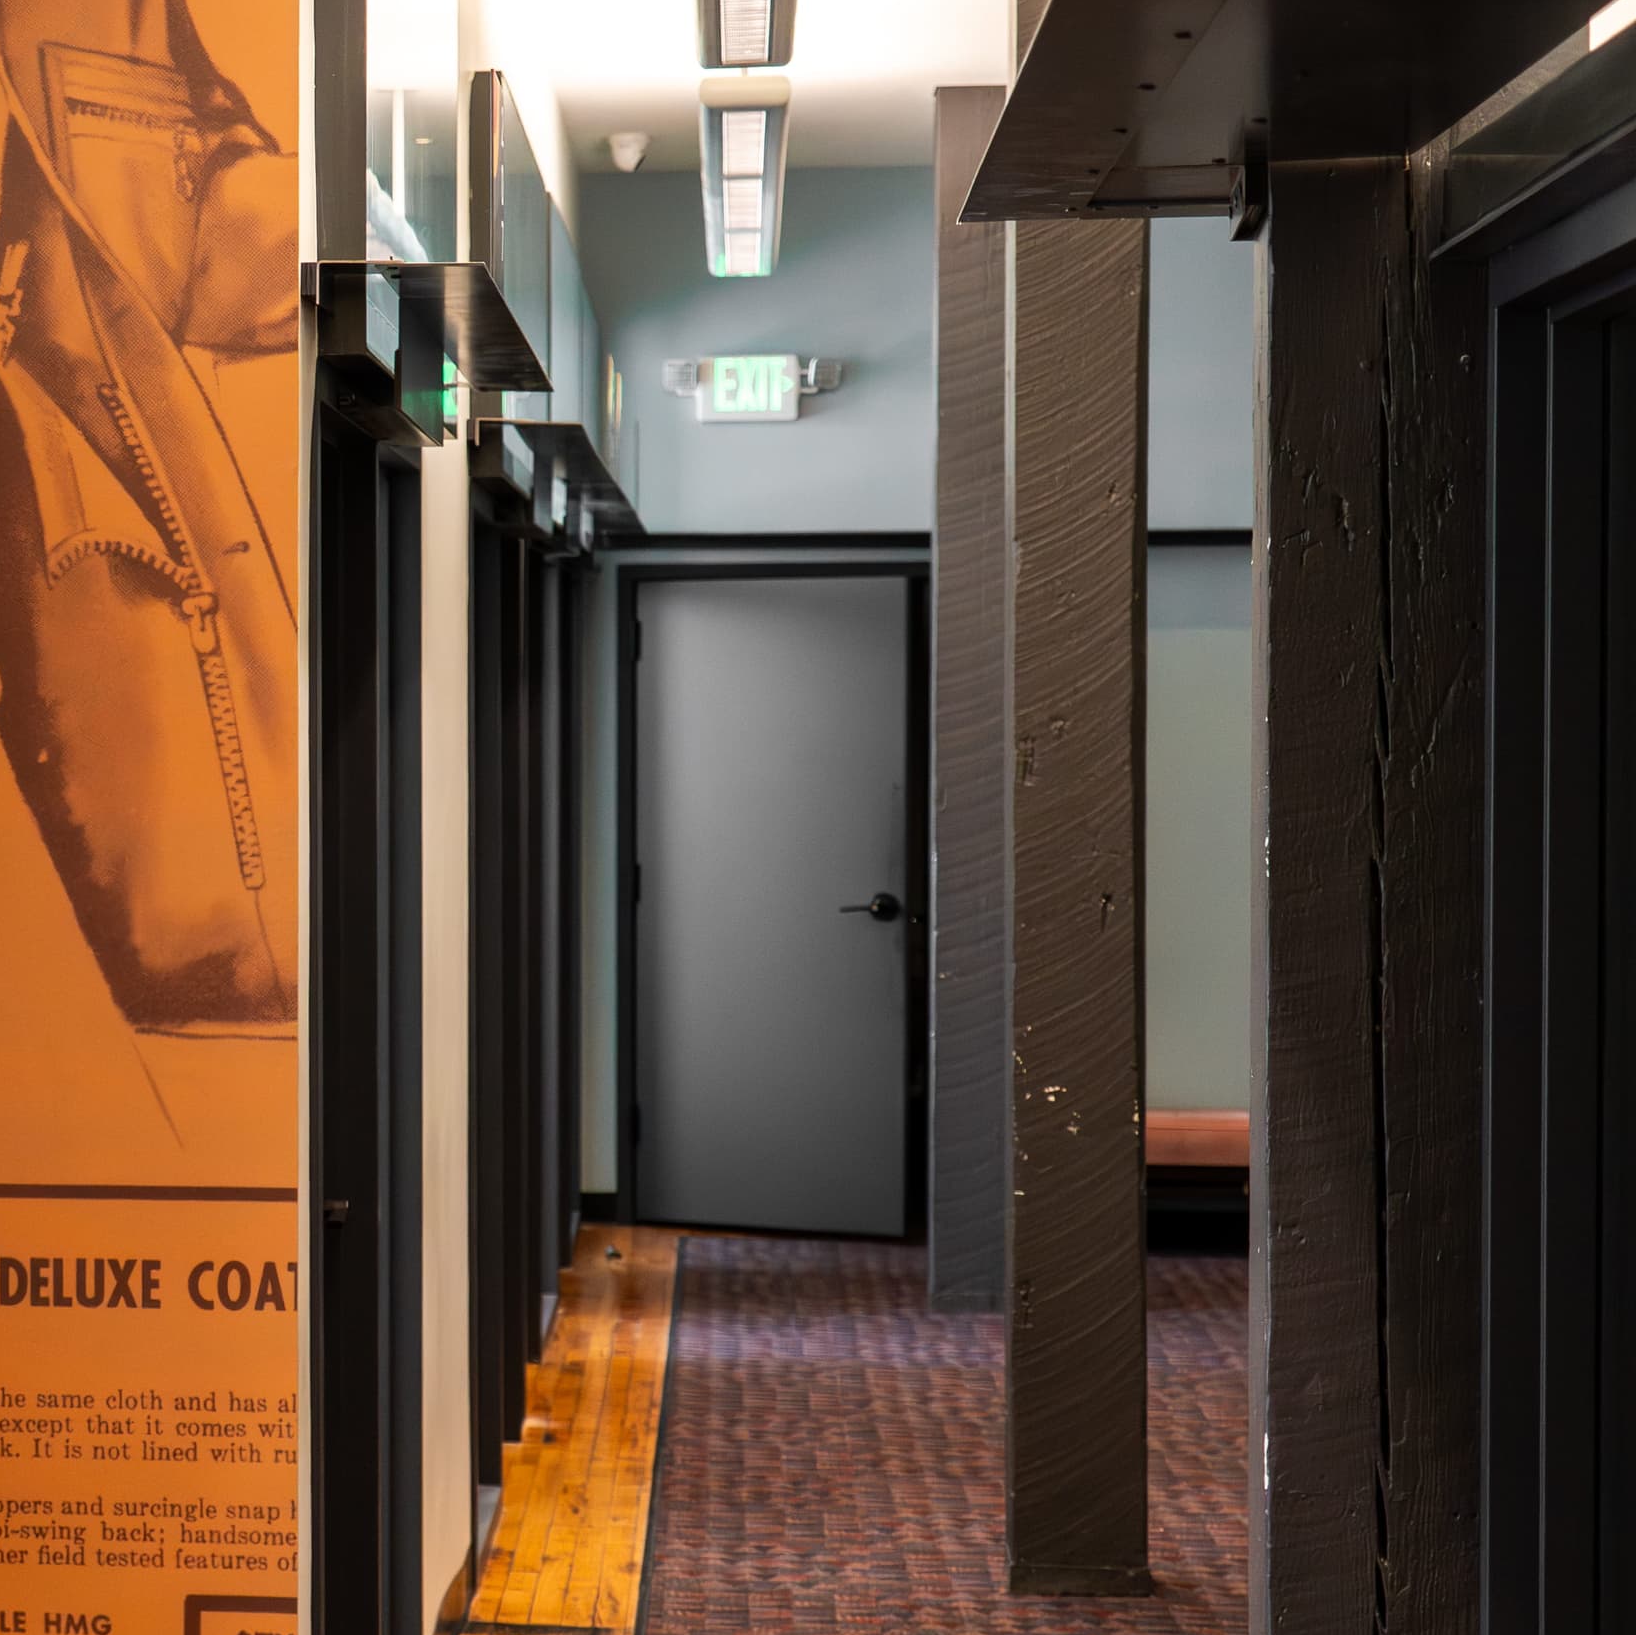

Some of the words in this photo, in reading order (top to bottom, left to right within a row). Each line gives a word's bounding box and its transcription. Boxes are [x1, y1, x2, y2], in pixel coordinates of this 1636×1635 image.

[714, 357, 786, 412] EXIT
[0, 1256, 161, 1309] DELUXE
[36, 1394, 95, 1409] same
[106, 1389, 163, 1410] cloth
[174, 1391, 217, 1412] and
[229, 1391, 267, 1413] has
[86, 1414, 134, 1435] that
[146, 1415, 163, 1435] it
[175, 1422, 246, 1437] comes
[258, 1418, 293, 1438] wit
[32, 1437, 52, 1458] It
[64, 1438, 82, 1459] is
[92, 1443, 130, 1460] not
[142, 1440, 198, 1462] lined
[210, 1442, 262, 1463] with
[61, 1495, 104, 1516] and
[113, 1497, 217, 1522] surcingle
[226, 1505, 280, 1525] snap
[100, 1521, 164, 1545] back;
[180, 1522, 297, 1546] handsome
[38, 1545, 86, 1566] field
[96, 1547, 164, 1568] tested
[176, 1548, 268, 1571] features
